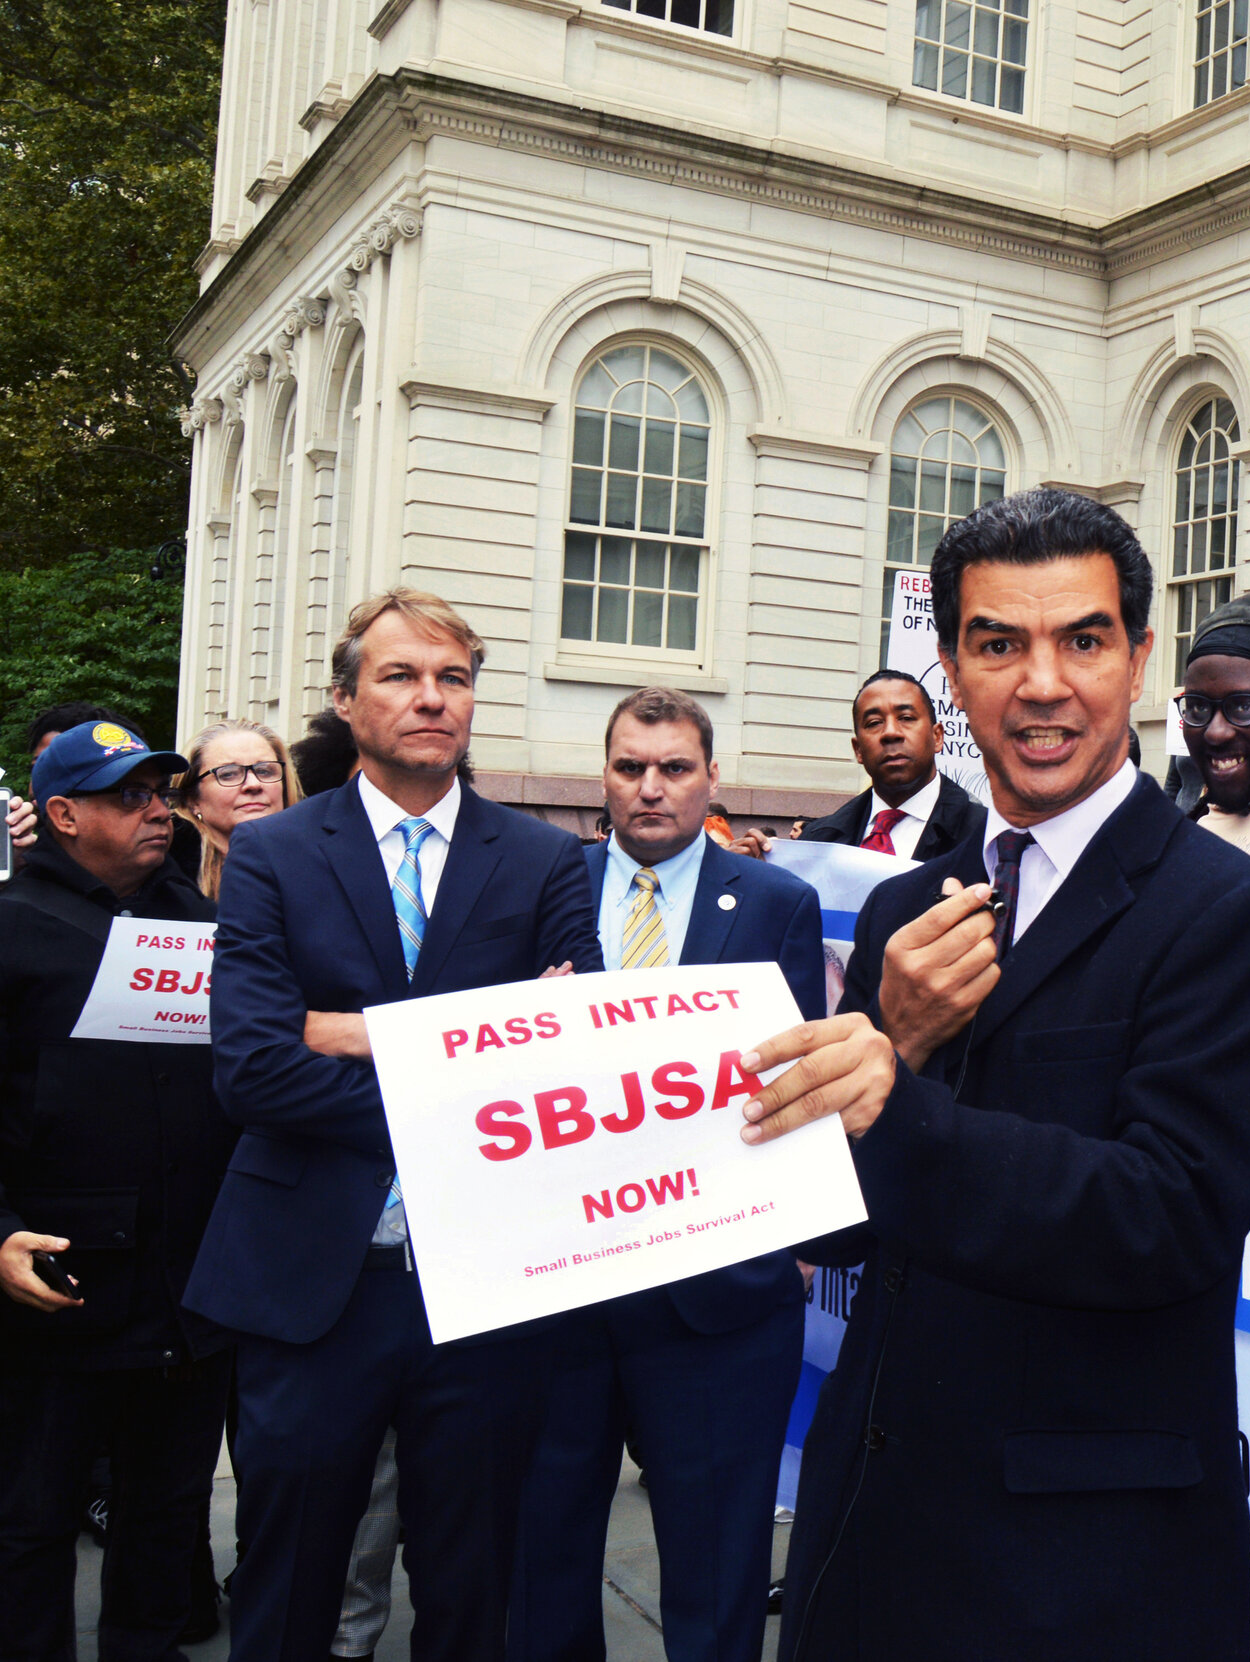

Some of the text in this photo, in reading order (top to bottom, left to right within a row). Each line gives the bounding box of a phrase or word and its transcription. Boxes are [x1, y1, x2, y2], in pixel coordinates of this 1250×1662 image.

[903, 615, 922, 630] OF
[136, 935, 186, 950] PASS
[129, 967, 212, 996] SBJ
[154, 1011, 207, 1025] NOW!
[441, 989, 742, 1059] PASS INTACT
[474, 1049, 765, 1162] SBJSA
[581, 1167, 702, 1224] NOW!
[523, 1200, 777, 1278] Small Business Jobs Survival Act
